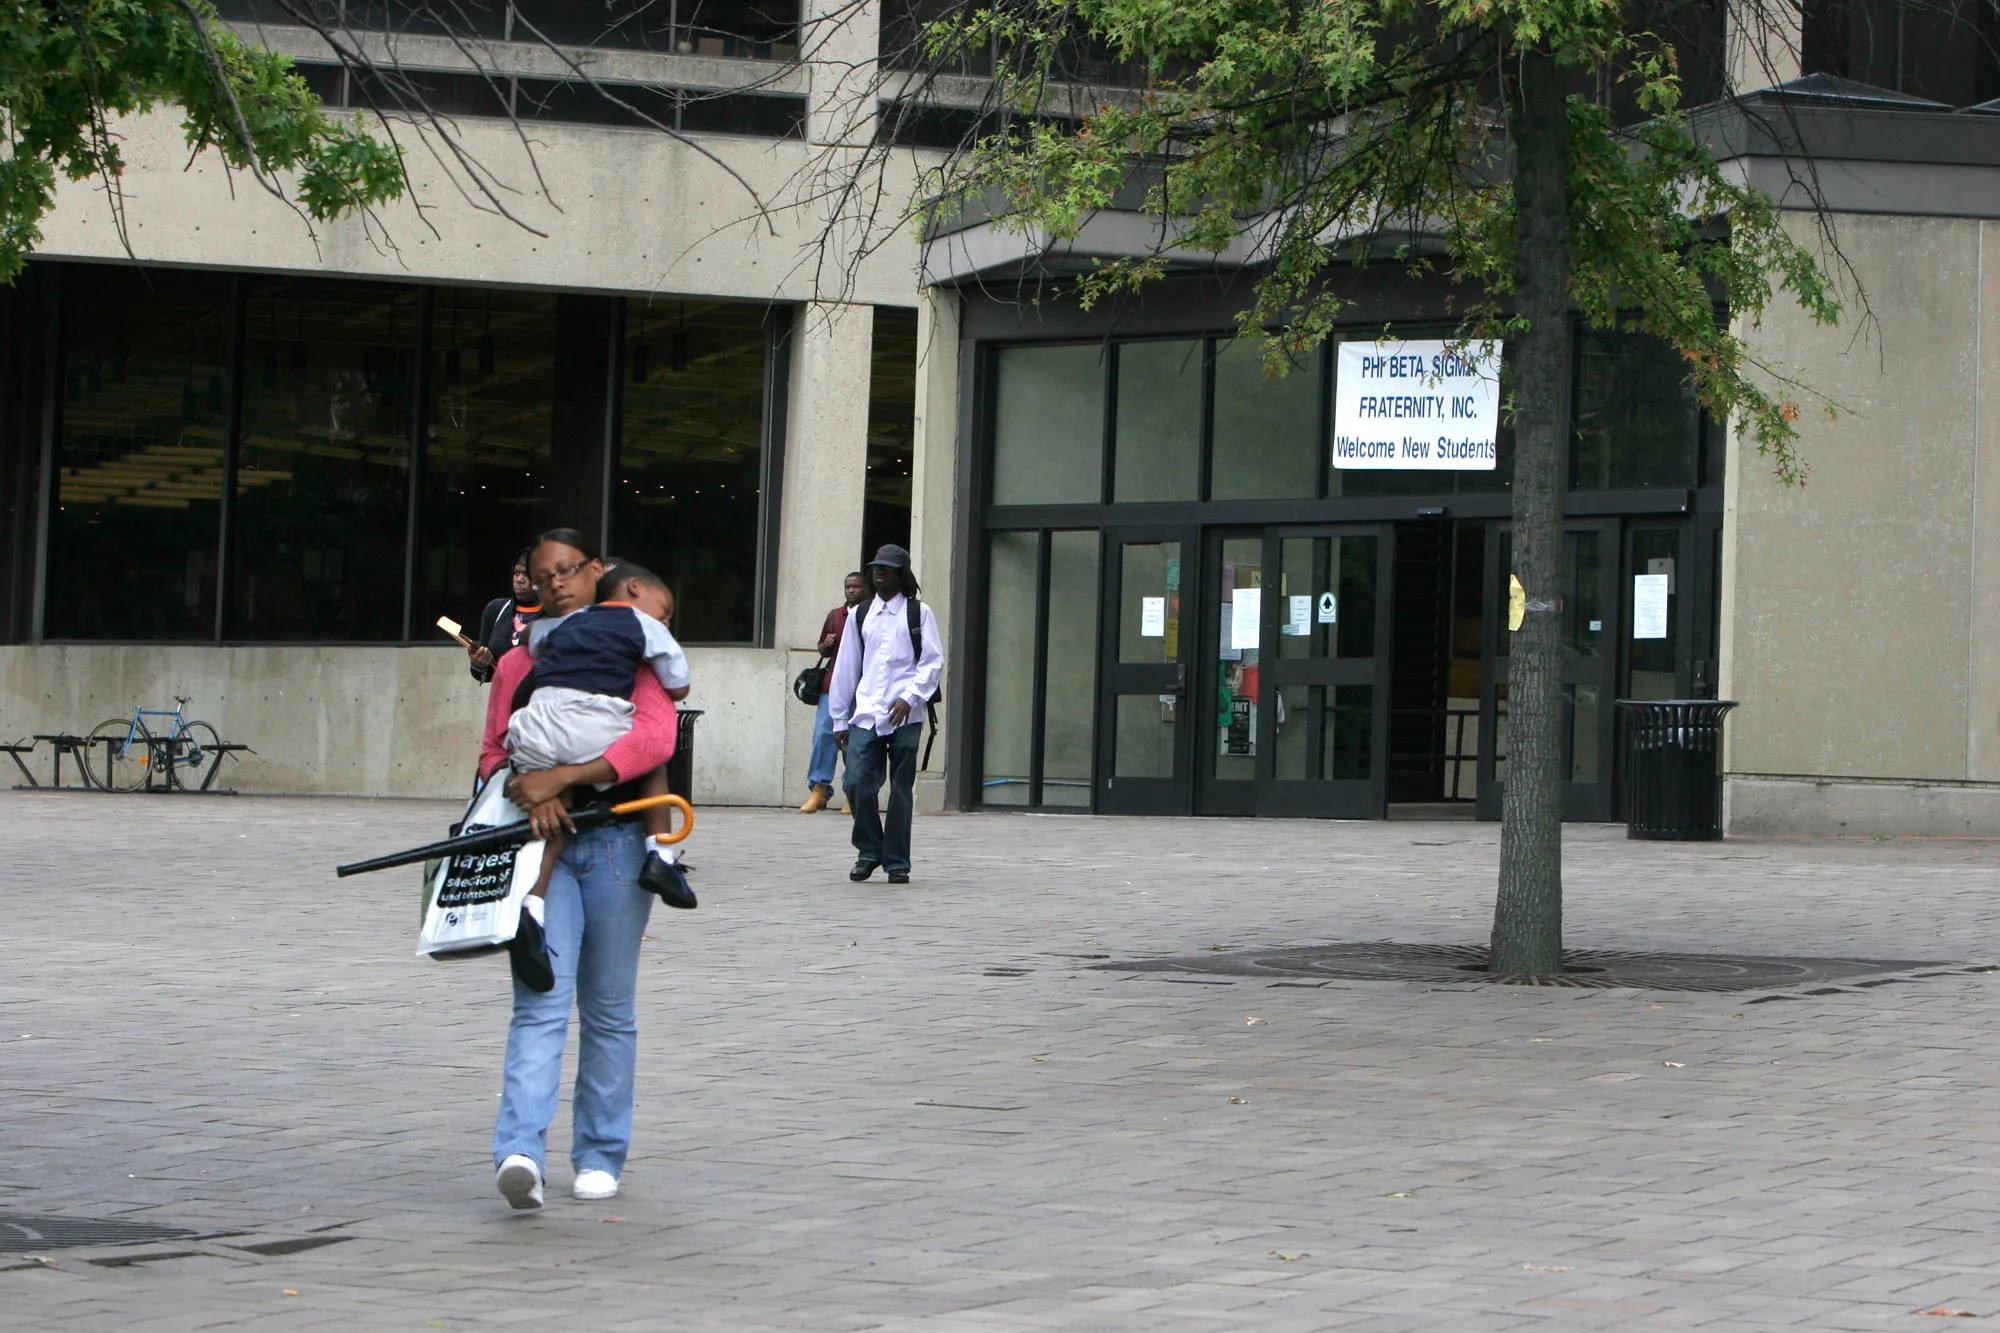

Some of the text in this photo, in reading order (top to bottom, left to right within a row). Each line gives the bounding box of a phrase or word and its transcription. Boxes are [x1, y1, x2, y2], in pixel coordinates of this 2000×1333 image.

[1362, 356, 1384, 378] PHI
[1389, 355, 1424, 378] BETA
[1359, 396, 1477, 423] FRATERNITY, INC.
[1337, 436, 1496, 459] Welcome New Students
[446, 874, 497, 888] slecion
